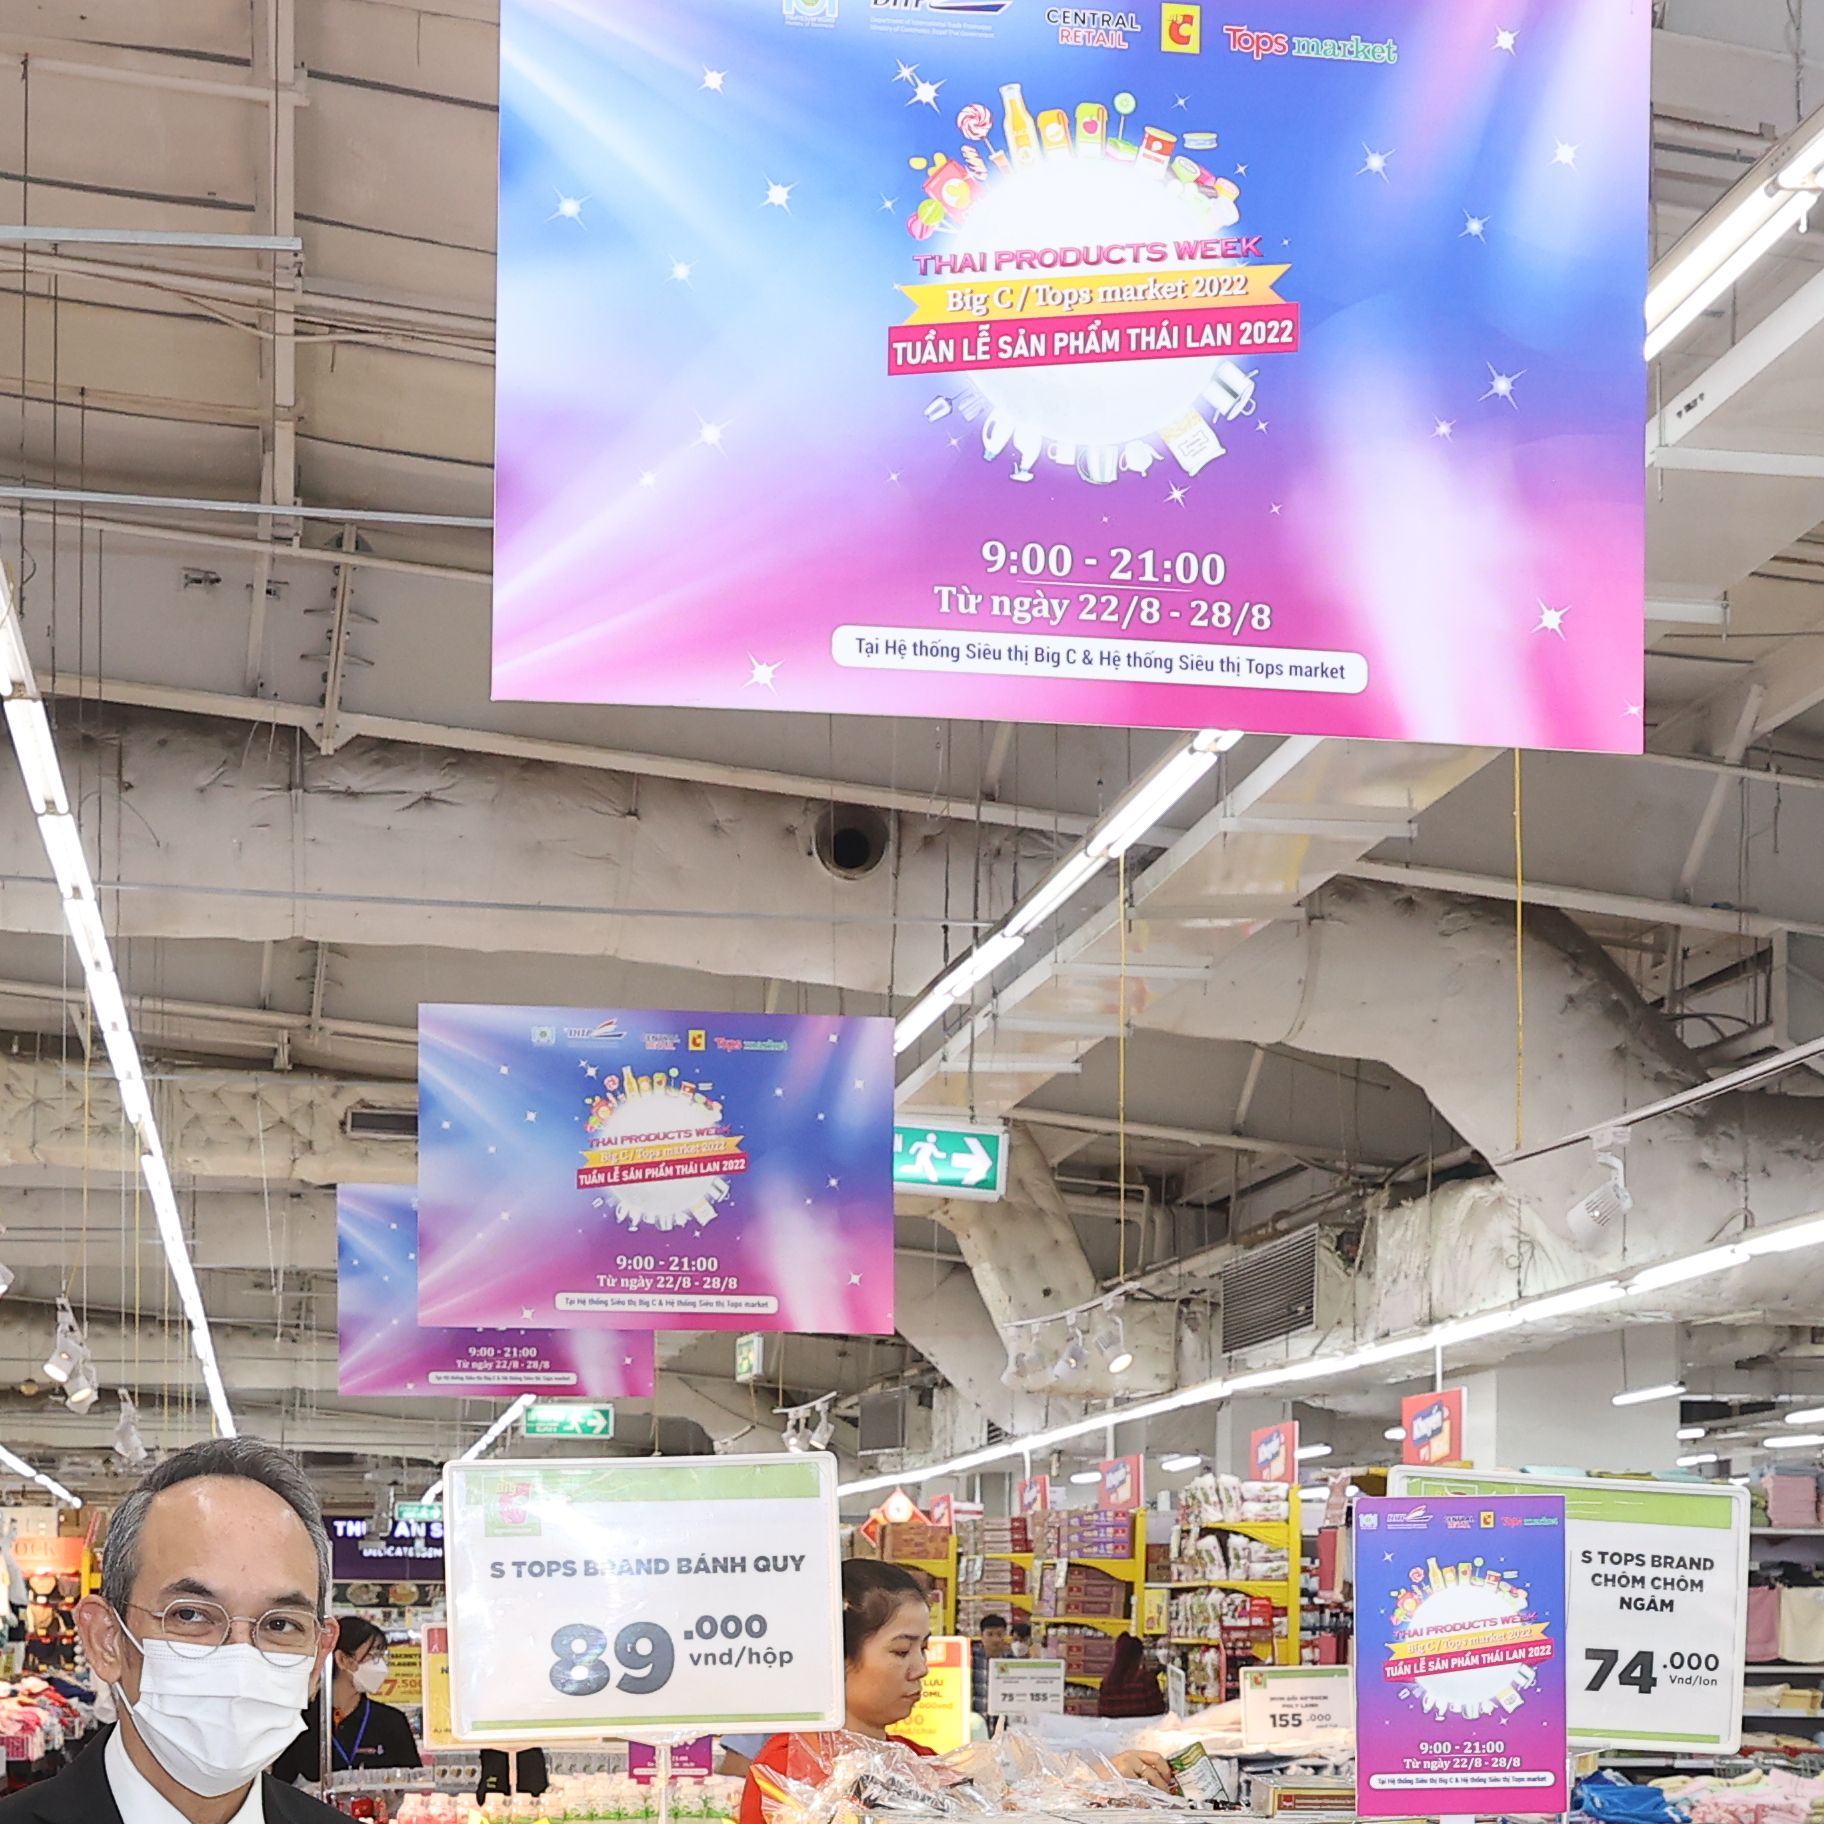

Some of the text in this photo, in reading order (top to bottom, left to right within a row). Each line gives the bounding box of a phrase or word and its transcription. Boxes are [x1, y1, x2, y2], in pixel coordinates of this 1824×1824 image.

[1046, 8, 1142, 32] CENTRAL
[1058, 27, 1128, 50] RETAIL
[1223, 25, 1398, 64] Tops market
[913, 235, 1264, 276] THAI PRODUCTS WEEK
[946, 275, 1248, 316] Big C Tops market 2022
[893, 319, 1294, 366] TUẦN LỄ SẢN PHẨM THÁI LAN 2022
[980, 540, 1227, 587] 9:00 21:00
[933, 585, 1274, 636] Từ ngày 22/8 28/8
[855, 638, 1347, 680] Tại Hệ thống Siêu thị Big C & Hệ thống Siêu thị Tops market
[616, 1255, 718, 1272] 9:00 21:00
[621, 1276, 653, 1290] ngày
[656, 1276, 691, 1289] 22/8
[703, 1277, 738, 1292] 28/8
[490, 1562, 505, 1578] S
[512, 1560, 577, 1577] TOPS
[677, 1553, 746, 1574] BÁNH
[753, 1555, 806, 1572] QUY
[1581, 1551, 1714, 1571] S TOPS BRAND
[1591, 1571, 1704, 1593] CHÔM CHÔM
[1619, 1596, 1675, 1612] NGÂM
[549, 1614, 768, 1696] 89 .000
[1584, 1648, 1720, 1694] 74 .000
[1270, 1713, 1302, 1727] 155
